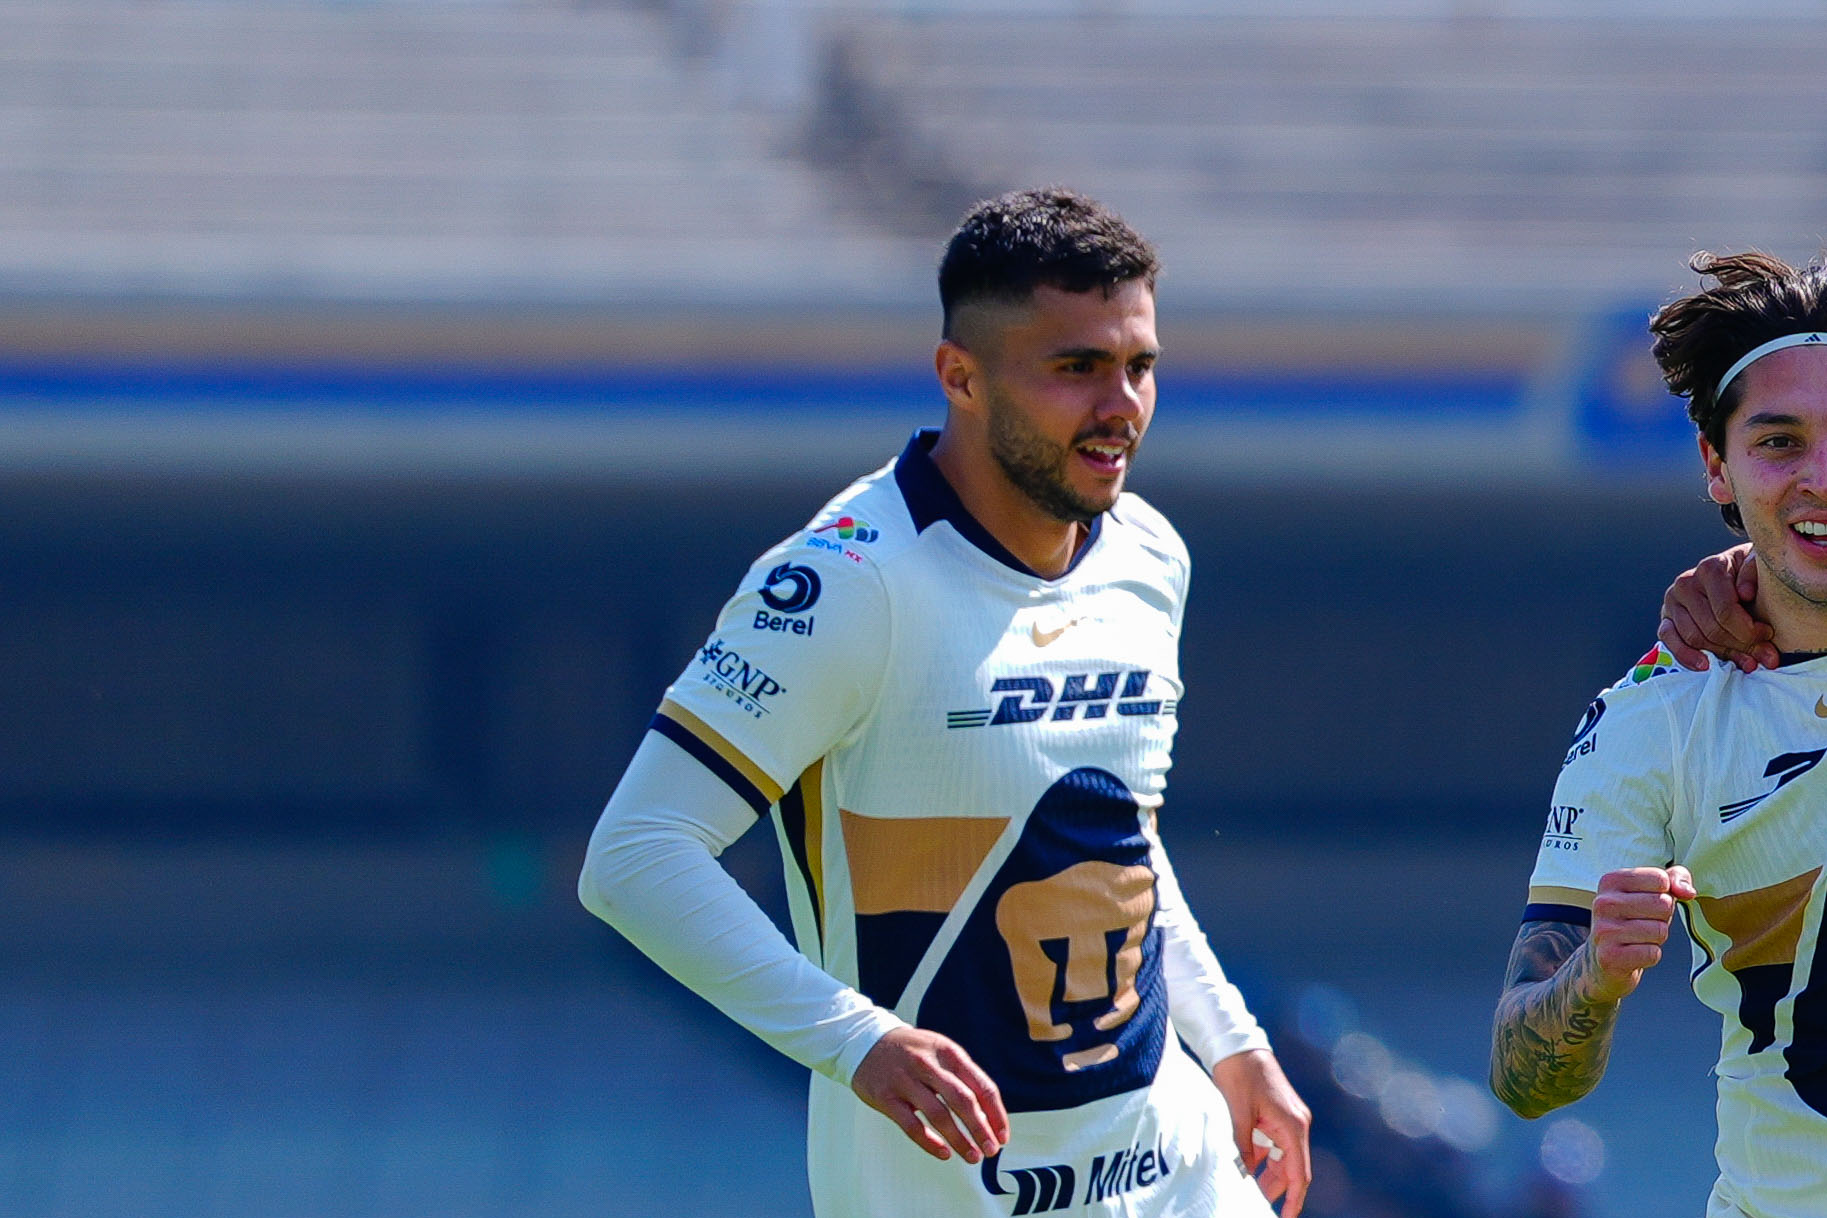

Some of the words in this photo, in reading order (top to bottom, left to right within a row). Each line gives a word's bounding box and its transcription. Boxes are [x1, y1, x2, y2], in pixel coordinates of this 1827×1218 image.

[752, 609, 815, 637] Berel
[715, 650, 781, 702] GNP
[989, 669, 1162, 727] DHL
[1561, 731, 1598, 769] erel
[1546, 805, 1580, 836] NP
[1083, 1132, 1170, 1206] Mifel
